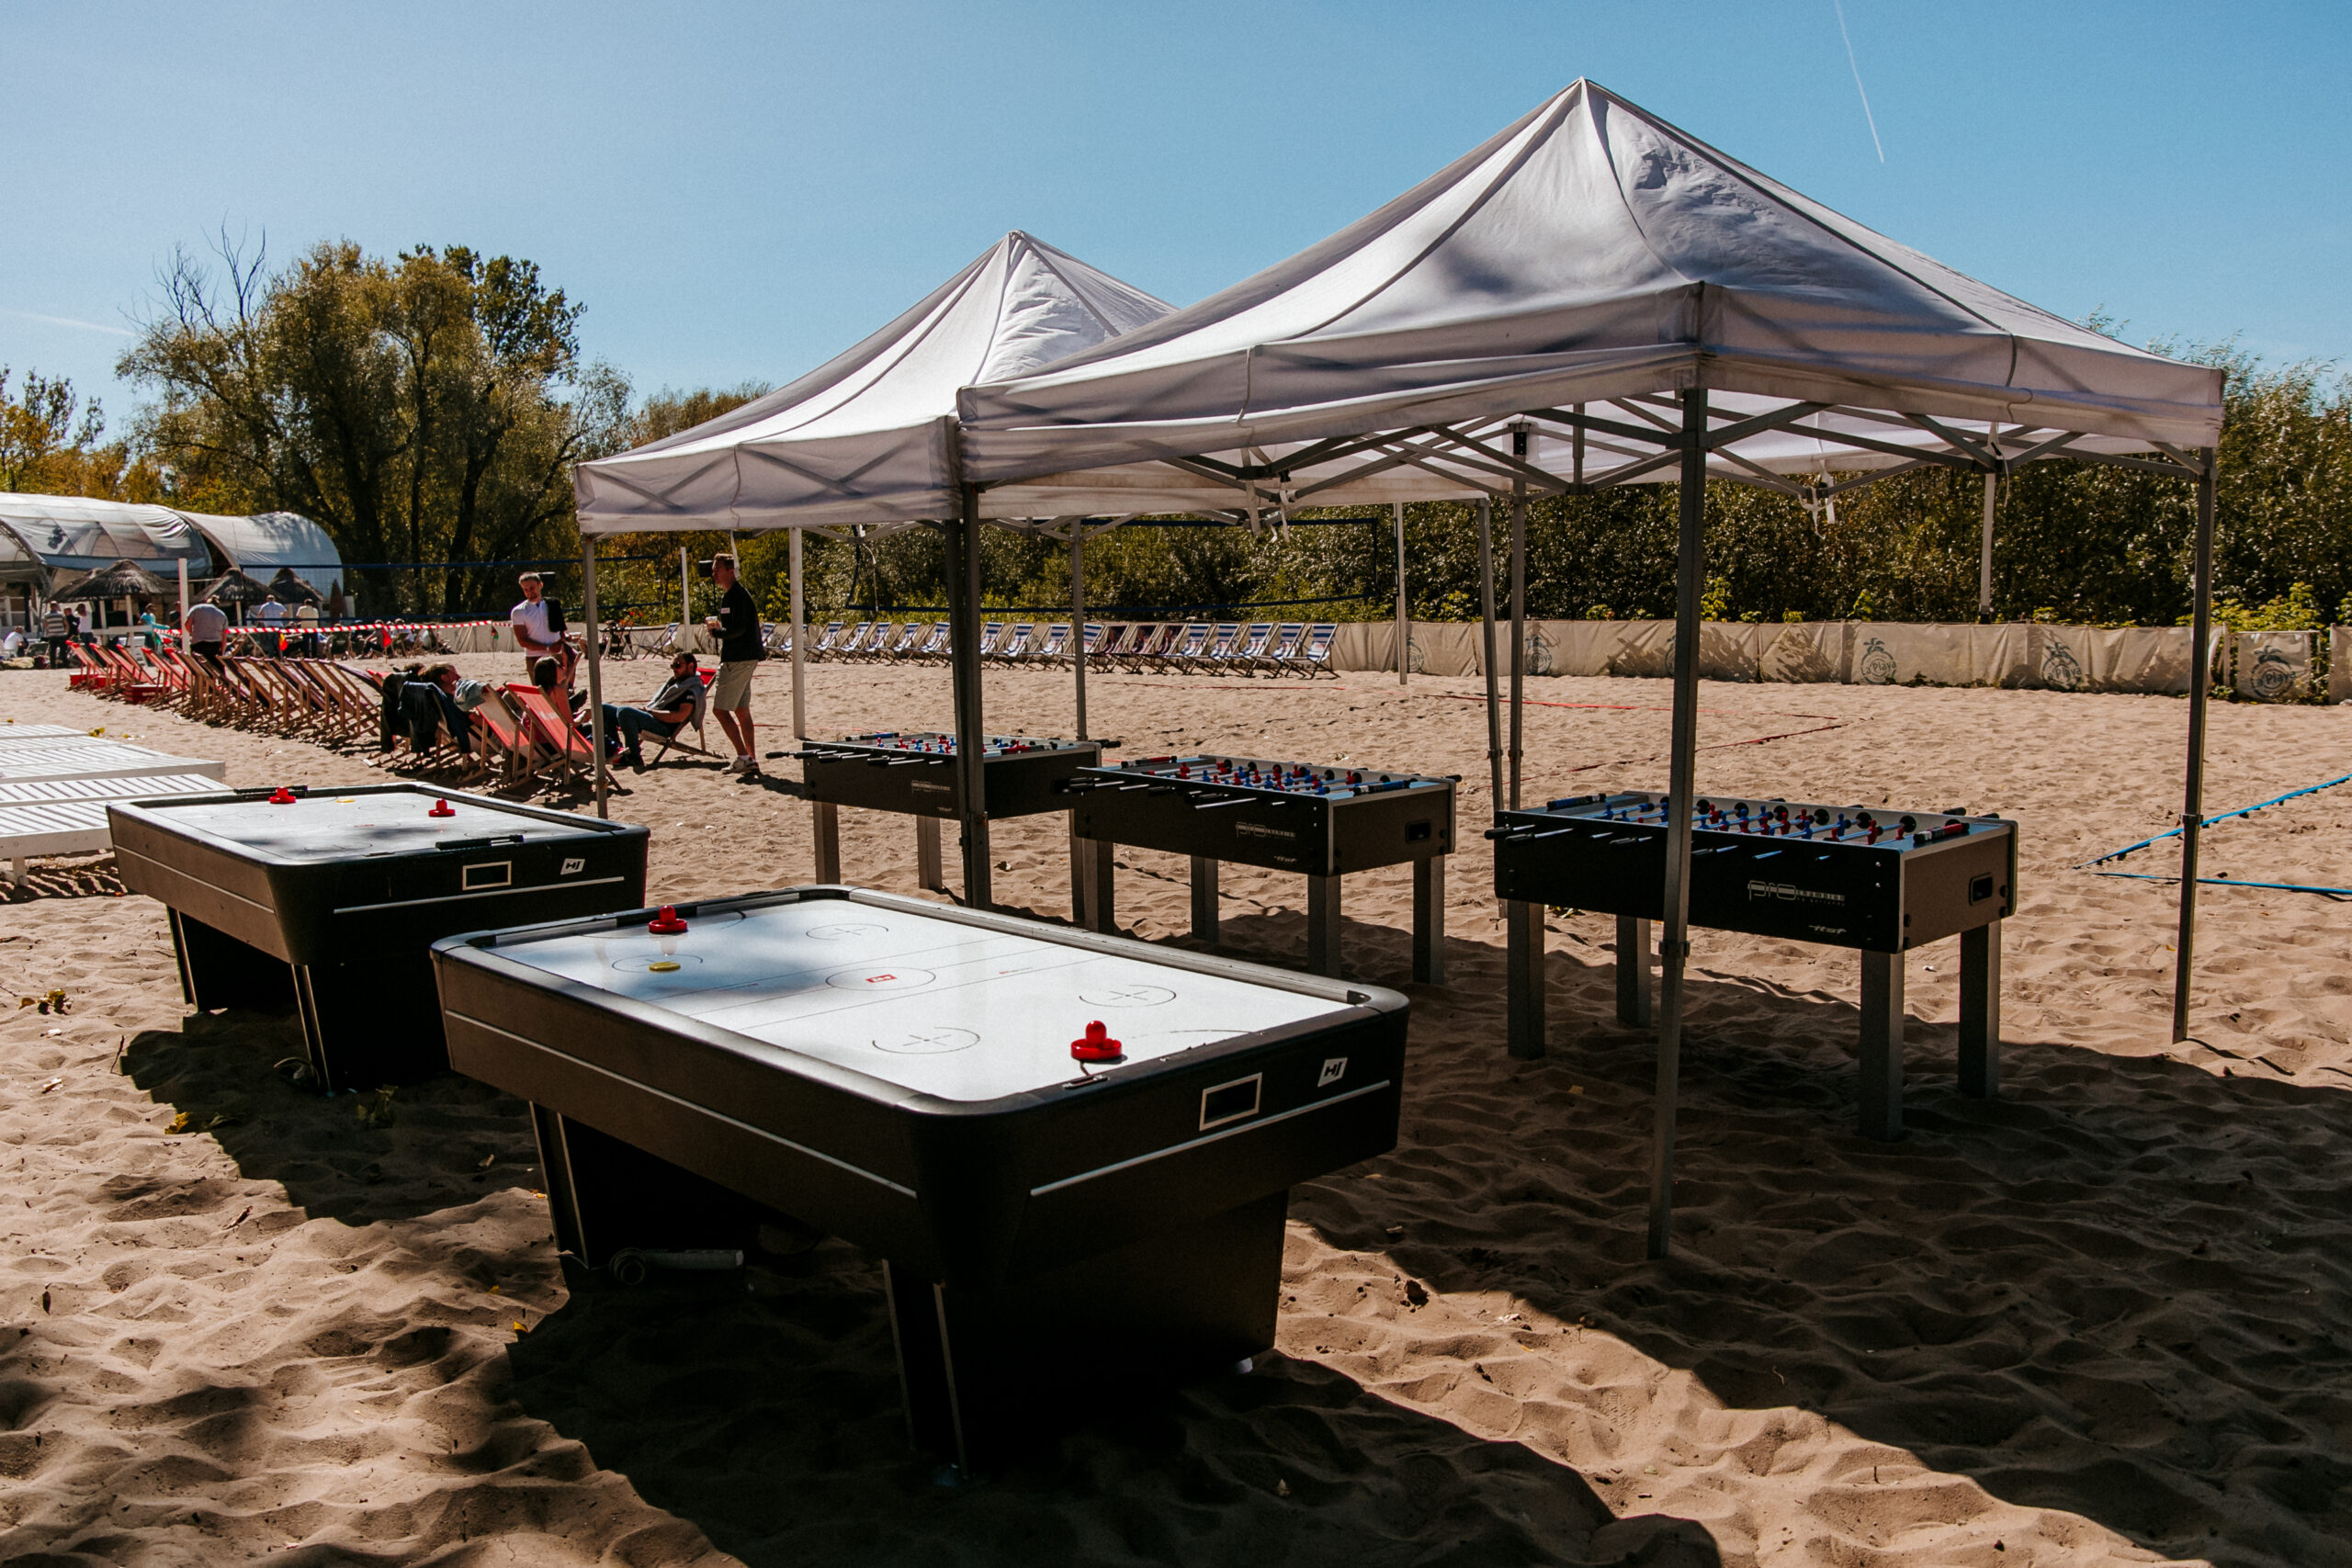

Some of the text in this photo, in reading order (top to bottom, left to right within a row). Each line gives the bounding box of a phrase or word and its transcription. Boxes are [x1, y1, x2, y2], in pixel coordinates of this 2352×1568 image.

[1860, 660, 1896, 675] La Playa
[2055, 667, 2081, 679] Playa
[2265, 671, 2296, 684] Playa
